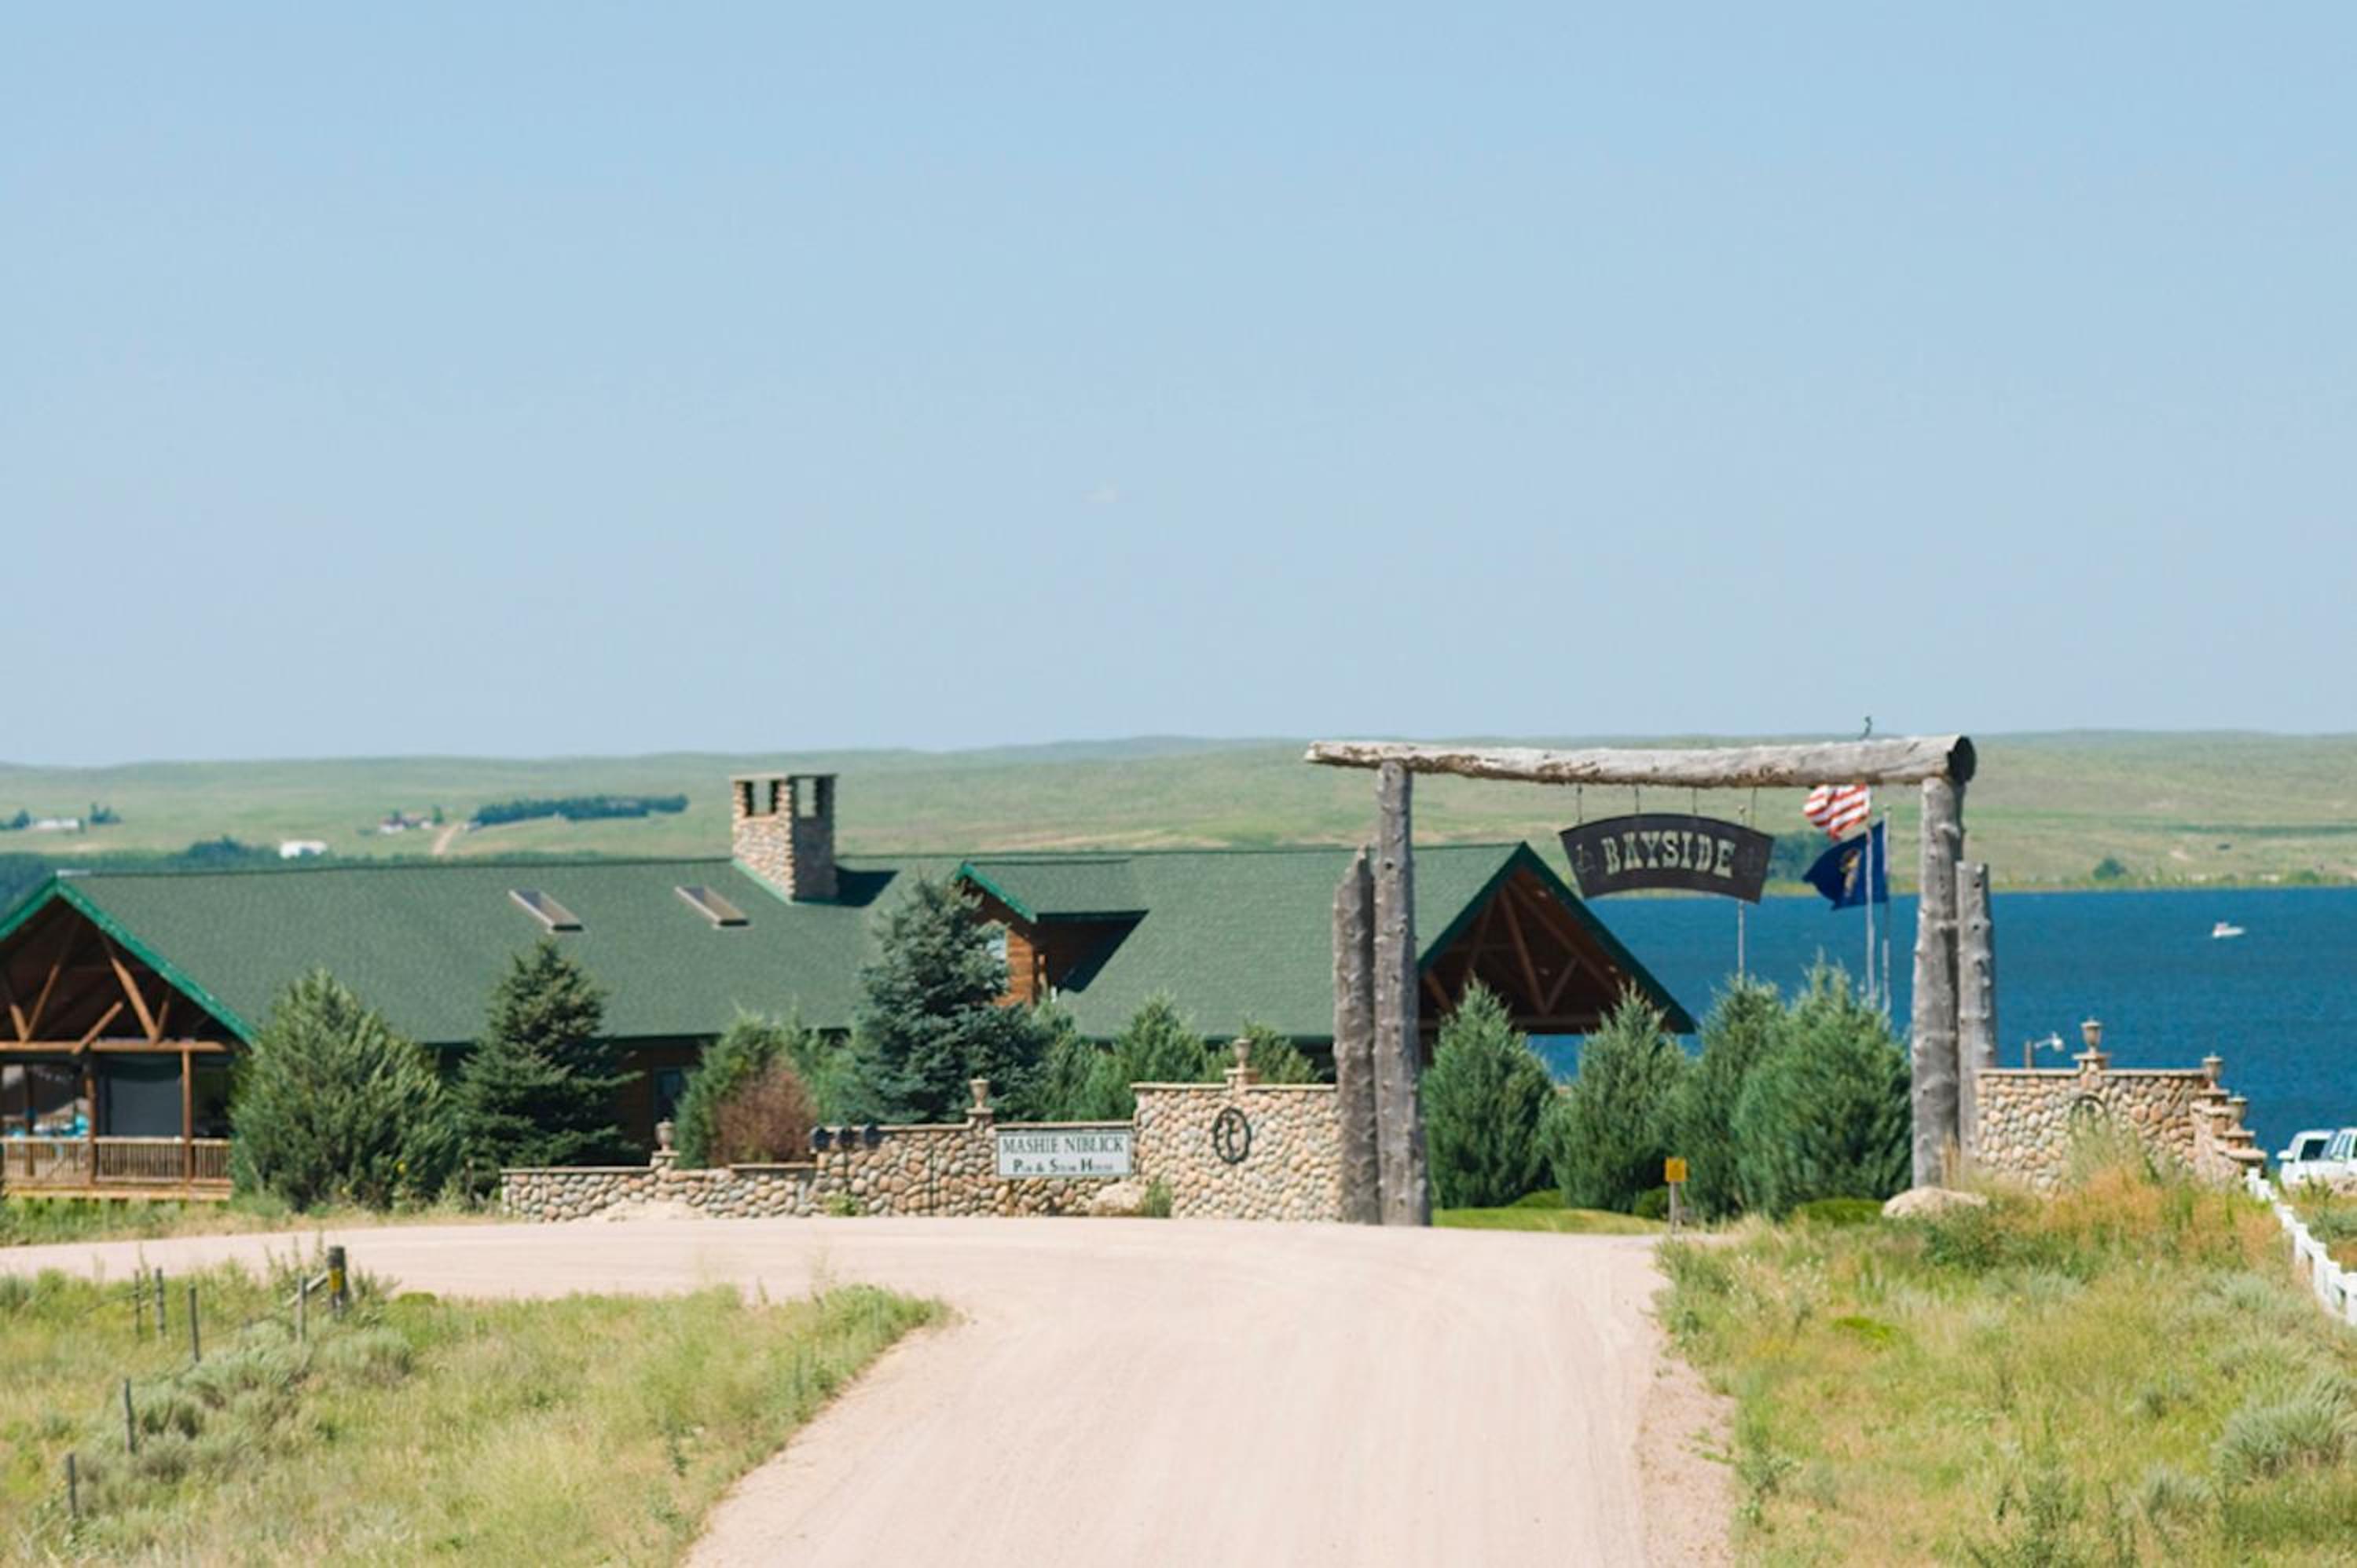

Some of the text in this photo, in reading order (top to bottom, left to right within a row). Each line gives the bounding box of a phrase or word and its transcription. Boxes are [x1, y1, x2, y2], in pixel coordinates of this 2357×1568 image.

[1600, 830, 1736, 879] BAYSIDE
[1003, 1136, 1124, 1153] MASHIE NIBLICK
